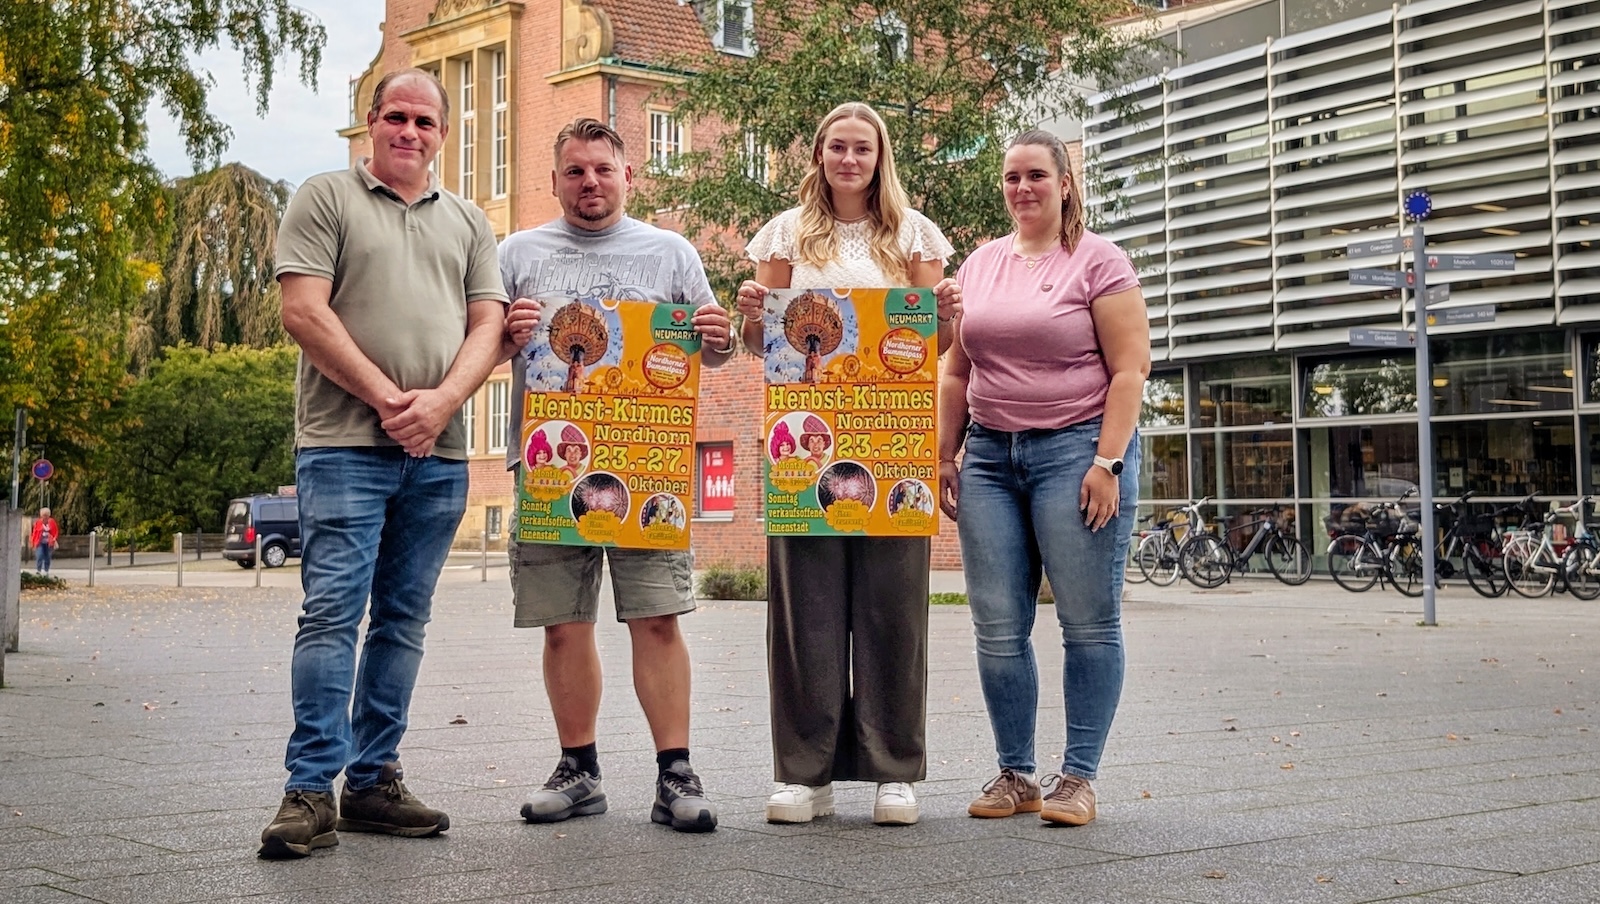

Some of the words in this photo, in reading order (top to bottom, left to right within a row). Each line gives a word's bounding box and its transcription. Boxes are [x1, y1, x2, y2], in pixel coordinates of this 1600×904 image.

[889, 313, 933, 325] NEUMARKT
[653, 329, 698, 341] NEUMARKT
[886, 340, 922, 351] Nordhorner
[883, 347, 923, 359] Bummelpass
[650, 354, 687, 368] Nordhorner
[646, 361, 686, 376] Bummelpass
[769, 384, 934, 410] Herbst-Kirmes
[528, 393, 694, 426] Herbst-Kirmes
[836, 413, 934, 430] Nordhorn
[594, 424, 692, 446] Nordhorn
[837, 433, 932, 459] 23.-27.
[592, 444, 689, 474] 23.-27.
[873, 461, 934, 479] Oktober
[628, 475, 689, 495] Oktober
[768, 493, 799, 506] Sonntag
[521, 500, 552, 514] Sonntag
[768, 507, 823, 519] verkaufsoffene
[520, 515, 576, 529] verkaufsoffene
[768, 521, 809, 532] Innenstadt
[519, 528, 561, 542] Innenstadt
